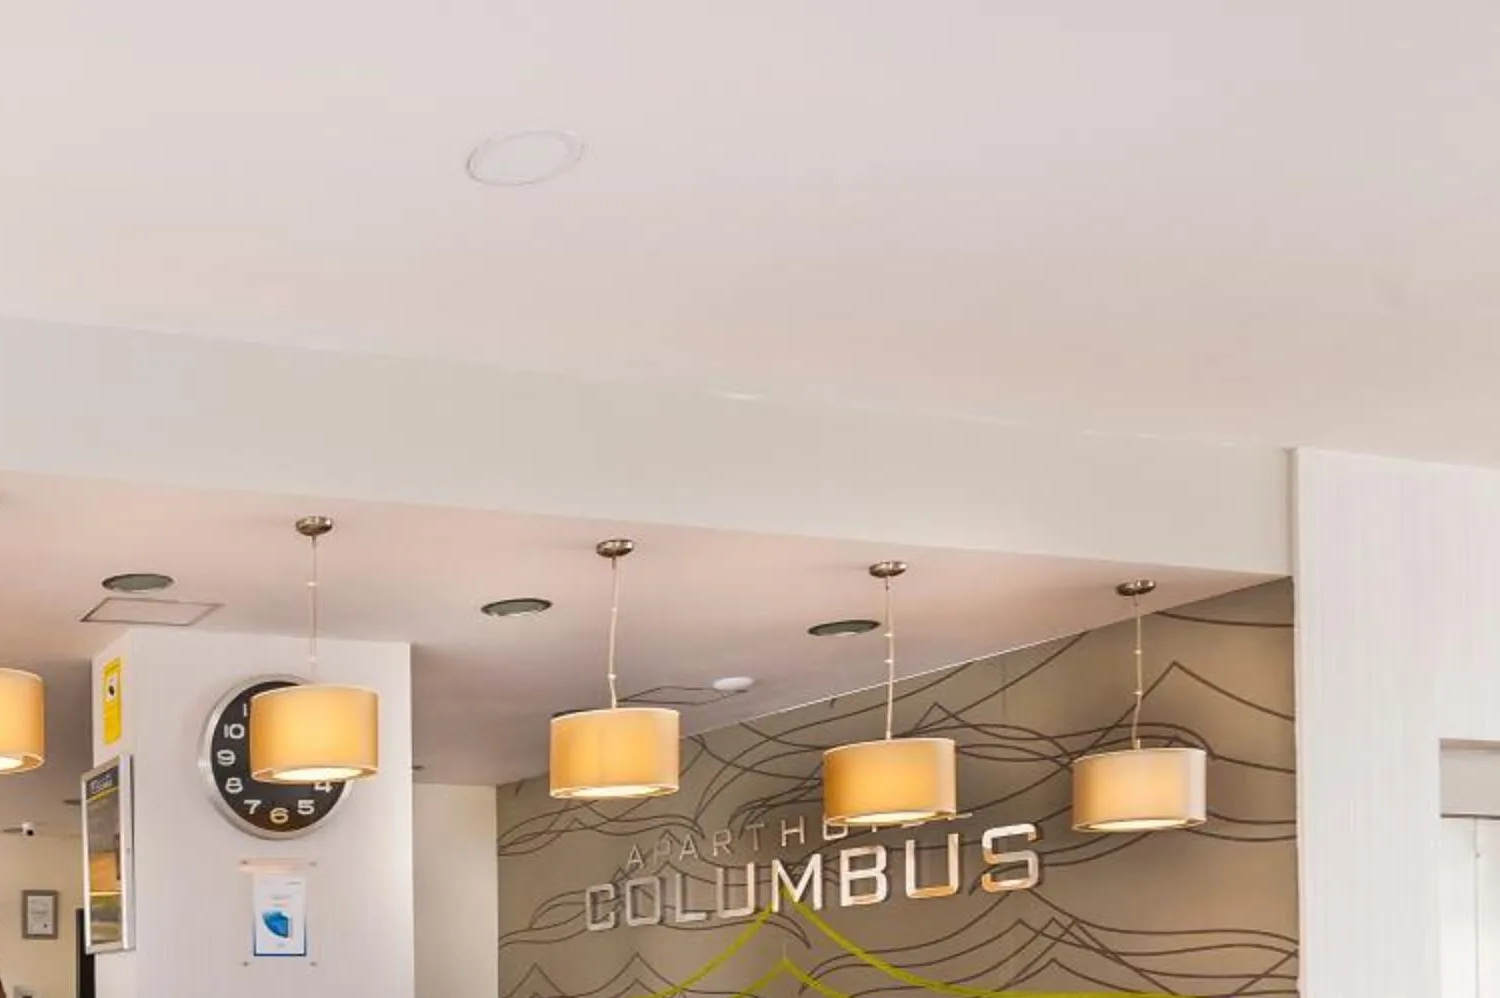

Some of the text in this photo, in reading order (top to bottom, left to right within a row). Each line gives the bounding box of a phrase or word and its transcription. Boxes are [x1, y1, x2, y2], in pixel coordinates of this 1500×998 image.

[223, 723, 245, 739] 10
[217, 749, 236, 767] 9
[225, 777, 243, 794] 8
[243, 799, 262, 815] 7
[269, 807, 289, 824] 6
[297, 799, 315, 815] 5
[585, 822, 1040, 932] COLUMBUS
